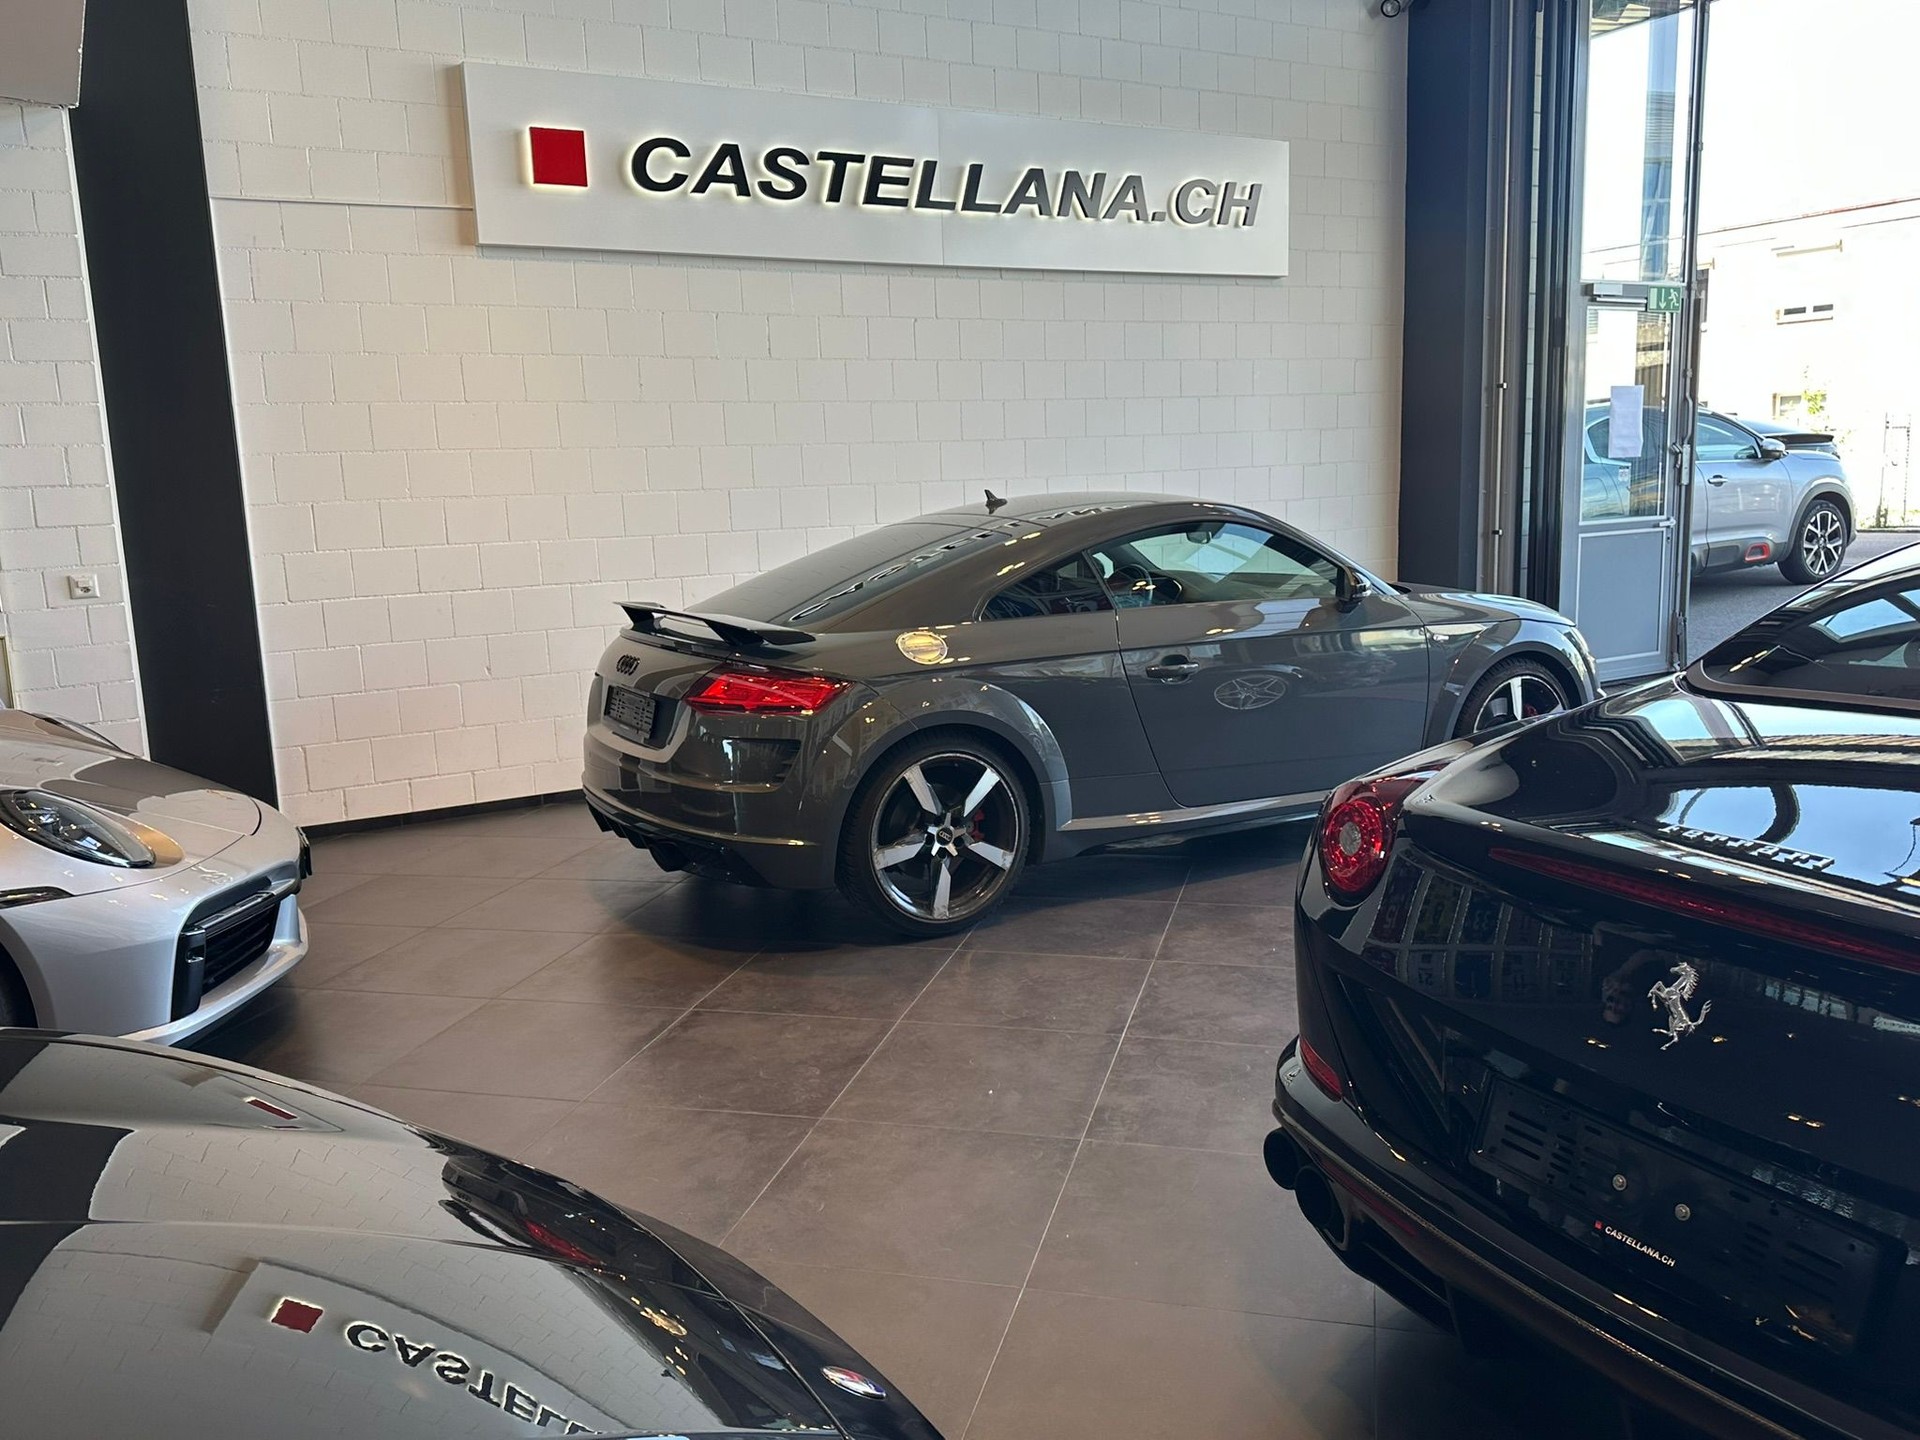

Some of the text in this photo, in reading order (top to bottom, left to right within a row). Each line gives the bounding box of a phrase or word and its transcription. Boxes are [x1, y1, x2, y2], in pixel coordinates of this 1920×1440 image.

[631, 137, 1262, 226] CASTELLANA.CH
[1657, 824, 1836, 873] Ferrari
[1604, 1225, 1676, 1267] CASTELLANA.CH
